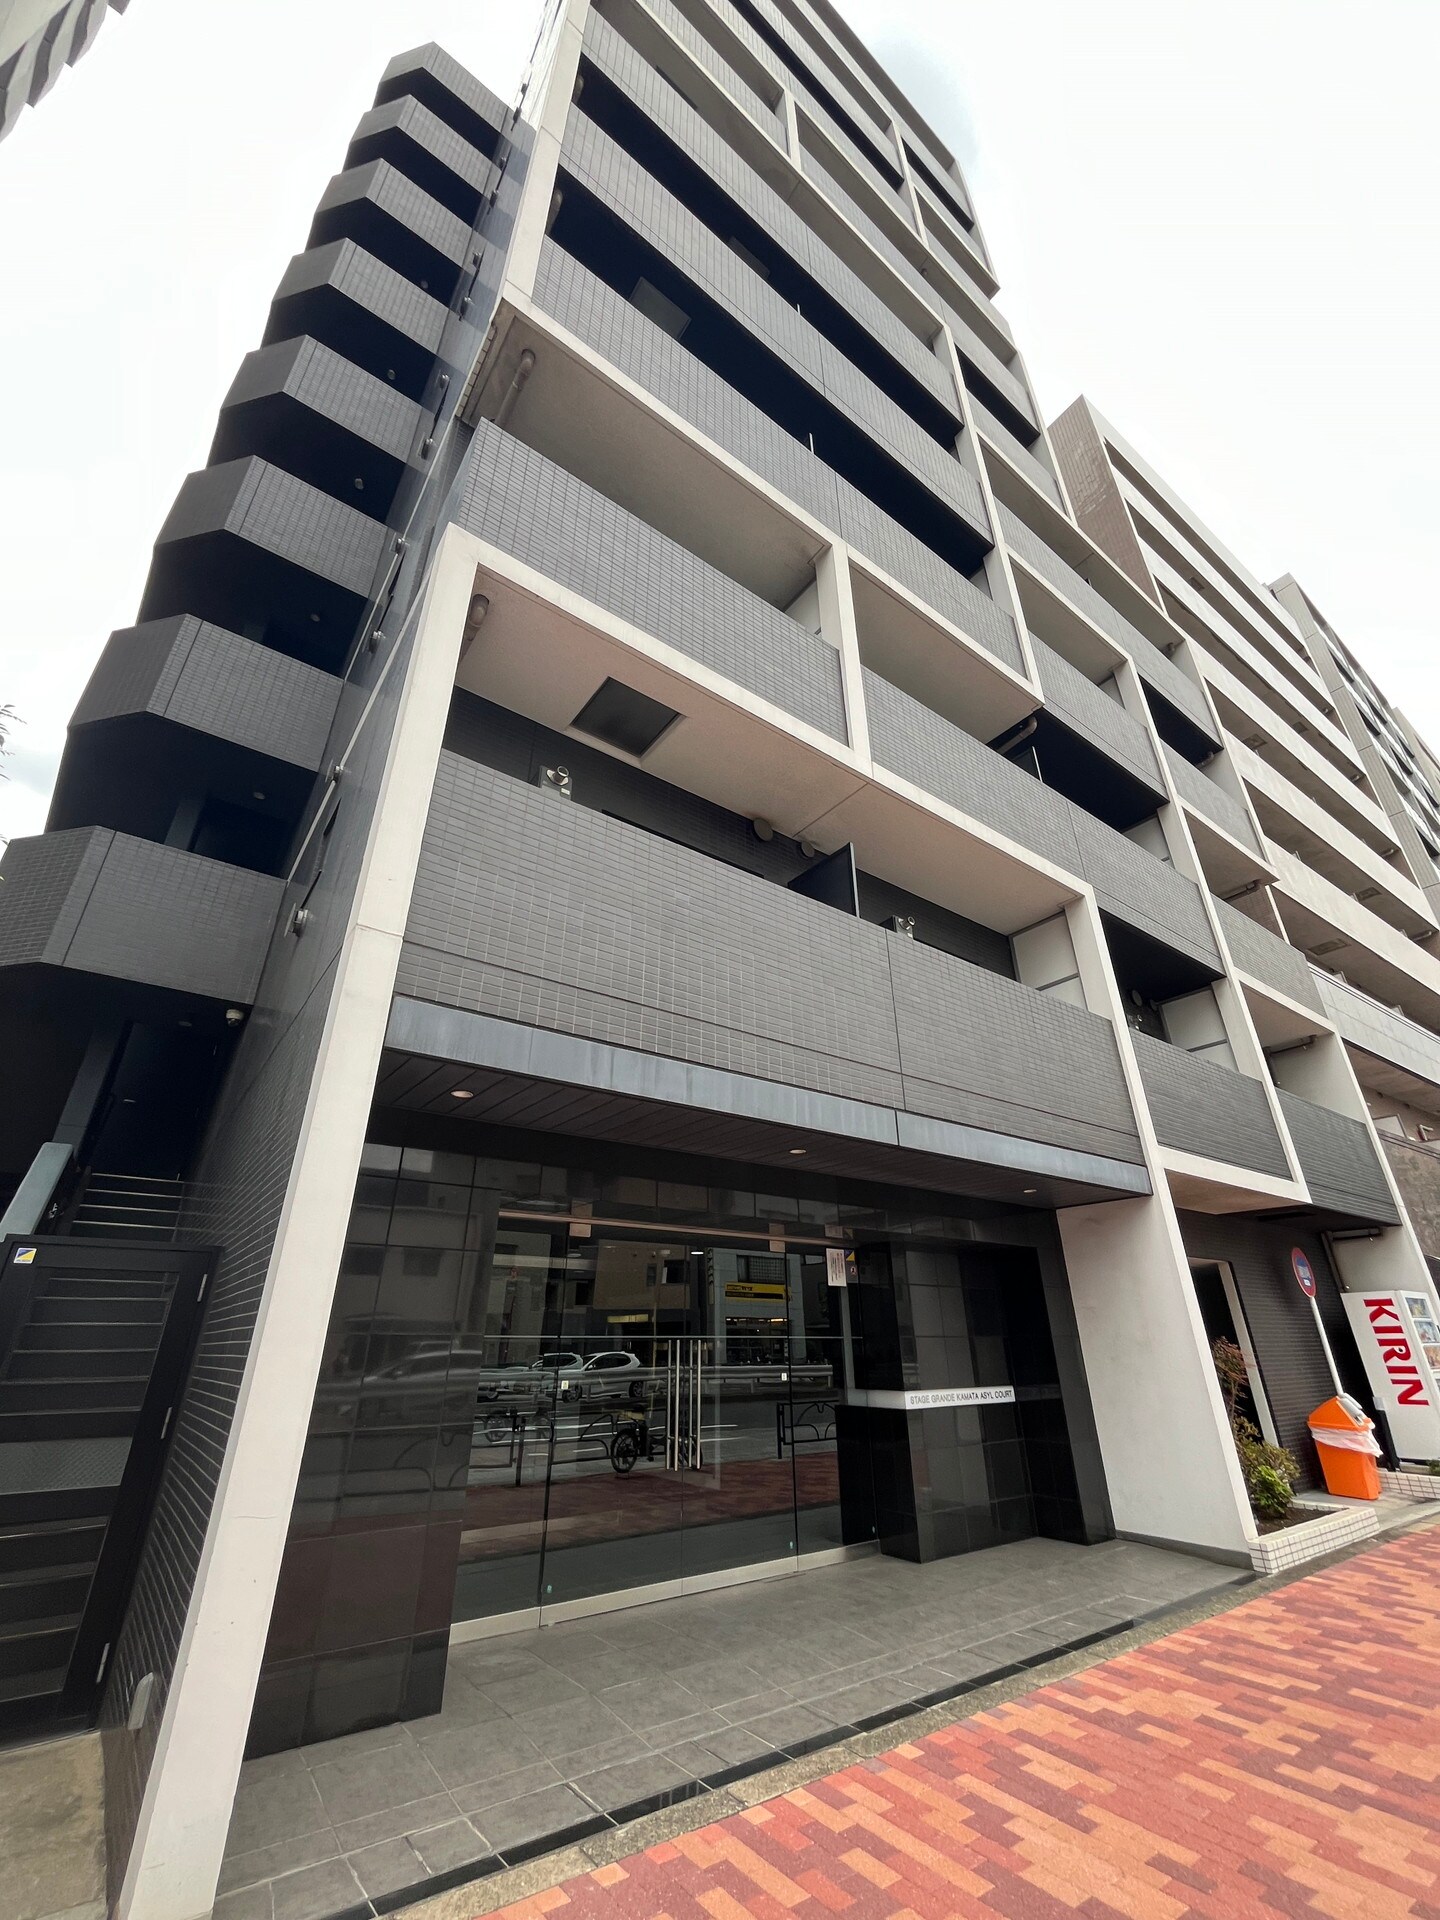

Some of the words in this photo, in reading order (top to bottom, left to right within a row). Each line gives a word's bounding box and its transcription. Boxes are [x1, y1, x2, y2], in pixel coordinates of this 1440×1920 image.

[1363, 1297, 1430, 1406] KIRIN
[910, 1395, 930, 1405] STAGE
[931, 1393, 955, 1403] GRANDE
[956, 1392, 979, 1401] KAMATA
[980, 1391, 994, 1399] ASYL
[995, 1390, 1012, 1399] COURT
